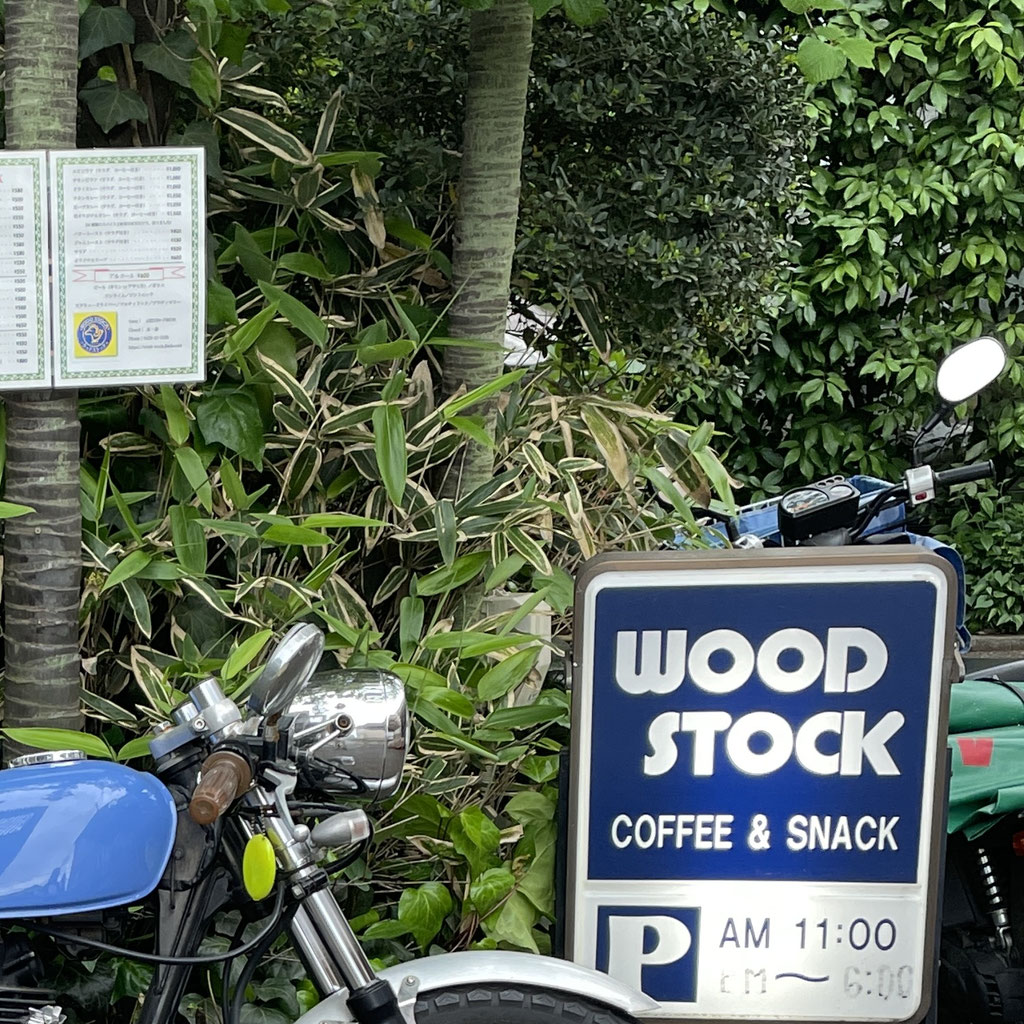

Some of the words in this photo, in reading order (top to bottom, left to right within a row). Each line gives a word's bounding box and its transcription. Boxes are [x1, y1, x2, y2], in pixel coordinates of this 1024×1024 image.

[614, 626, 889, 695] WOOD
[643, 710, 905, 777] STOCK
[611, 814, 734, 850] COFFEE
[748, 814, 773, 851] &
[787, 814, 900, 851] SNACK
[608, 915, 692, 1001] P
[719, 917, 771, 949] AM
[795, 918, 897, 951] 11:00
